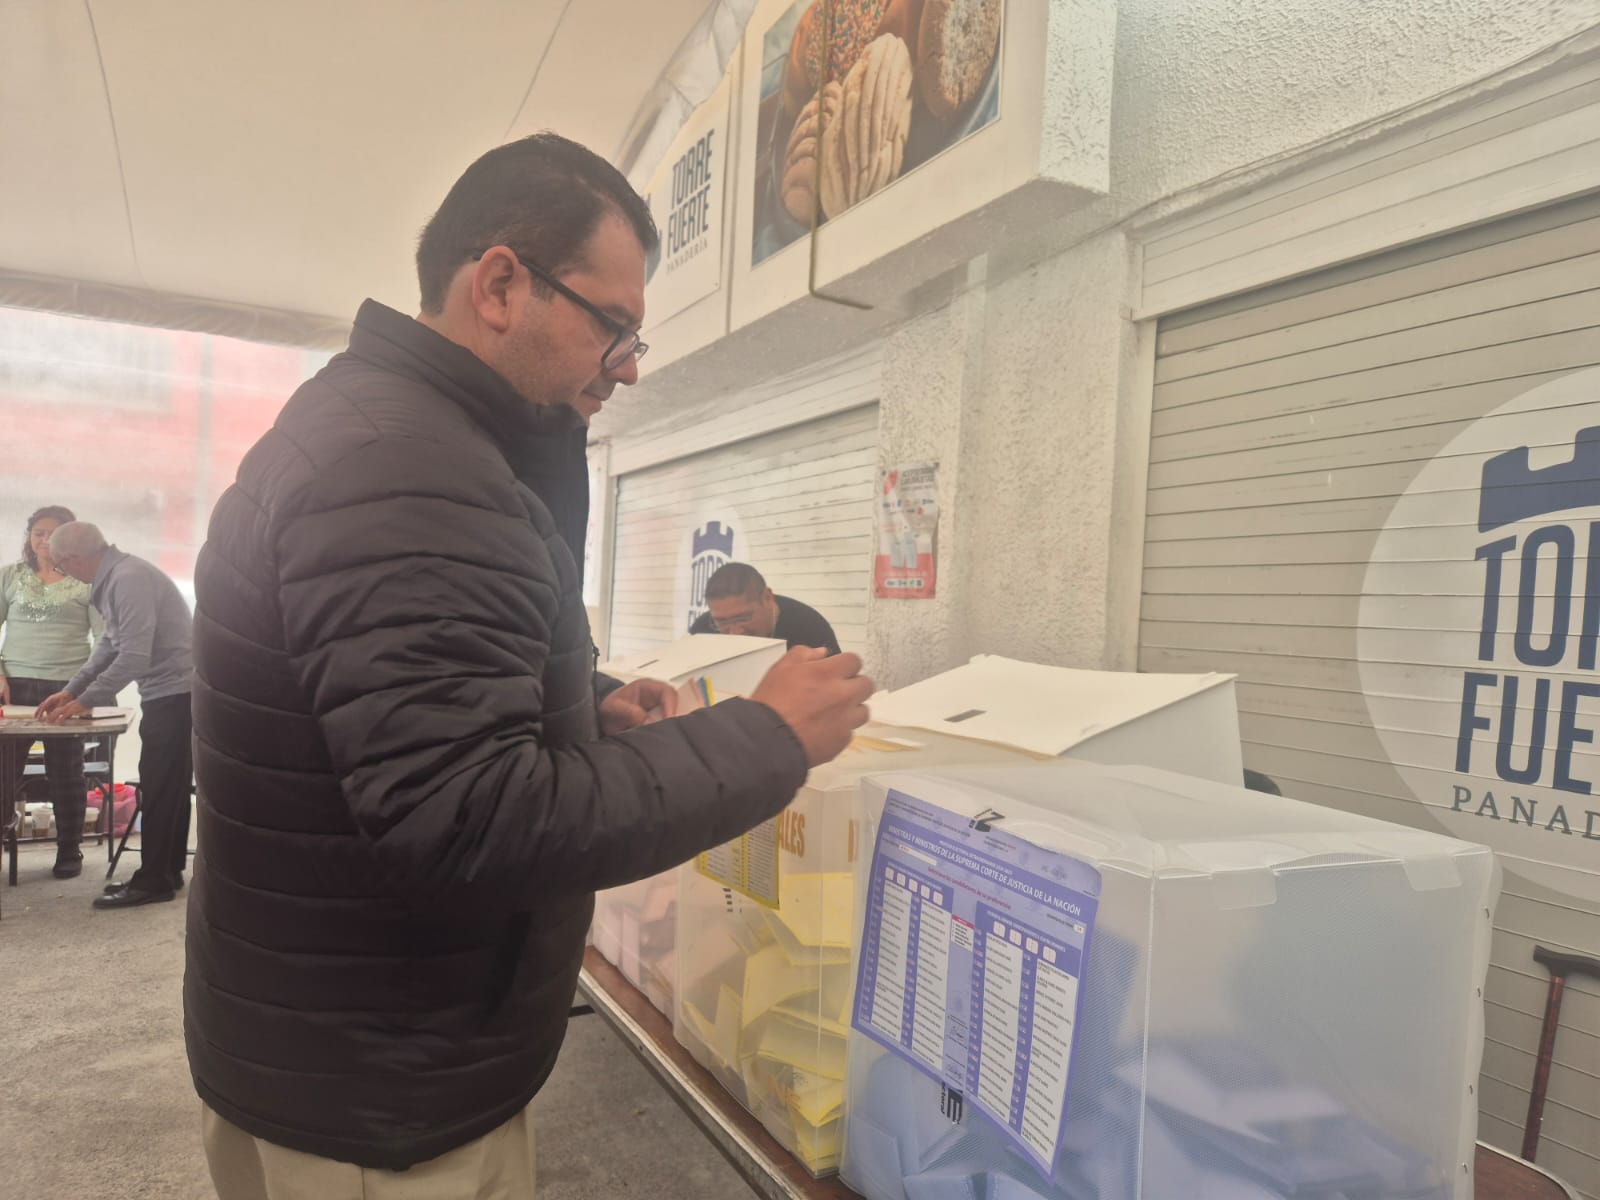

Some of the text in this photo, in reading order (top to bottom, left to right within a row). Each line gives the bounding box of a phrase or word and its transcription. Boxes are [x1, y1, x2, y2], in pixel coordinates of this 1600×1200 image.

[672, 128, 715, 210] TORRE
[667, 183, 711, 259] FUERTE
[1454, 671, 1600, 796] FUE
[955, 854, 980, 872] SUPREMA
[980, 865, 999, 880] CORTE
[998, 873, 1008, 885] DE
[1007, 878, 1033, 896] JUSTICIA
[1034, 888, 1044, 900] DE
[1043, 892, 1052, 904] LA
[1053, 896, 1081, 916] NACIÓN
